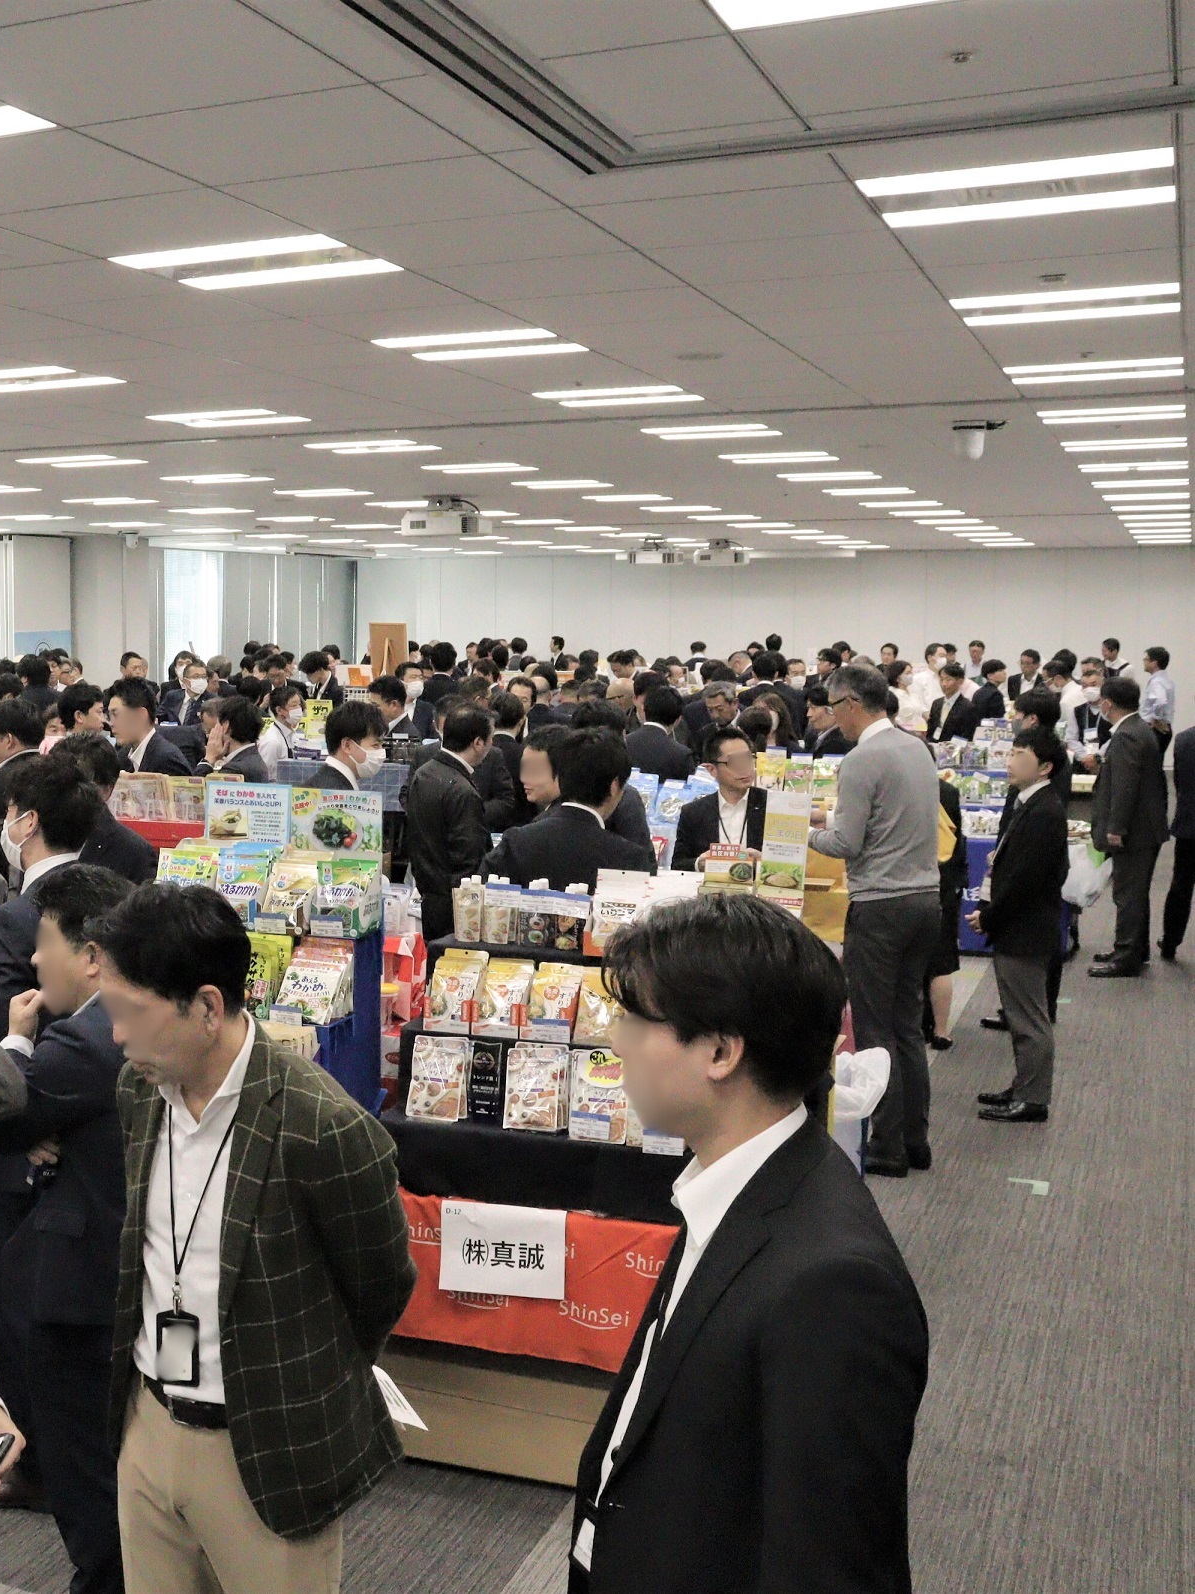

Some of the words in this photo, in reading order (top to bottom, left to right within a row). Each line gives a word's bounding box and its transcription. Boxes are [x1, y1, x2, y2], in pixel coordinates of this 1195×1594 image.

[445, 1207, 462, 1215] D-12
[462, 1236, 545, 1271] ㈱真誠
[558, 1300, 630, 1327] ShinSei
